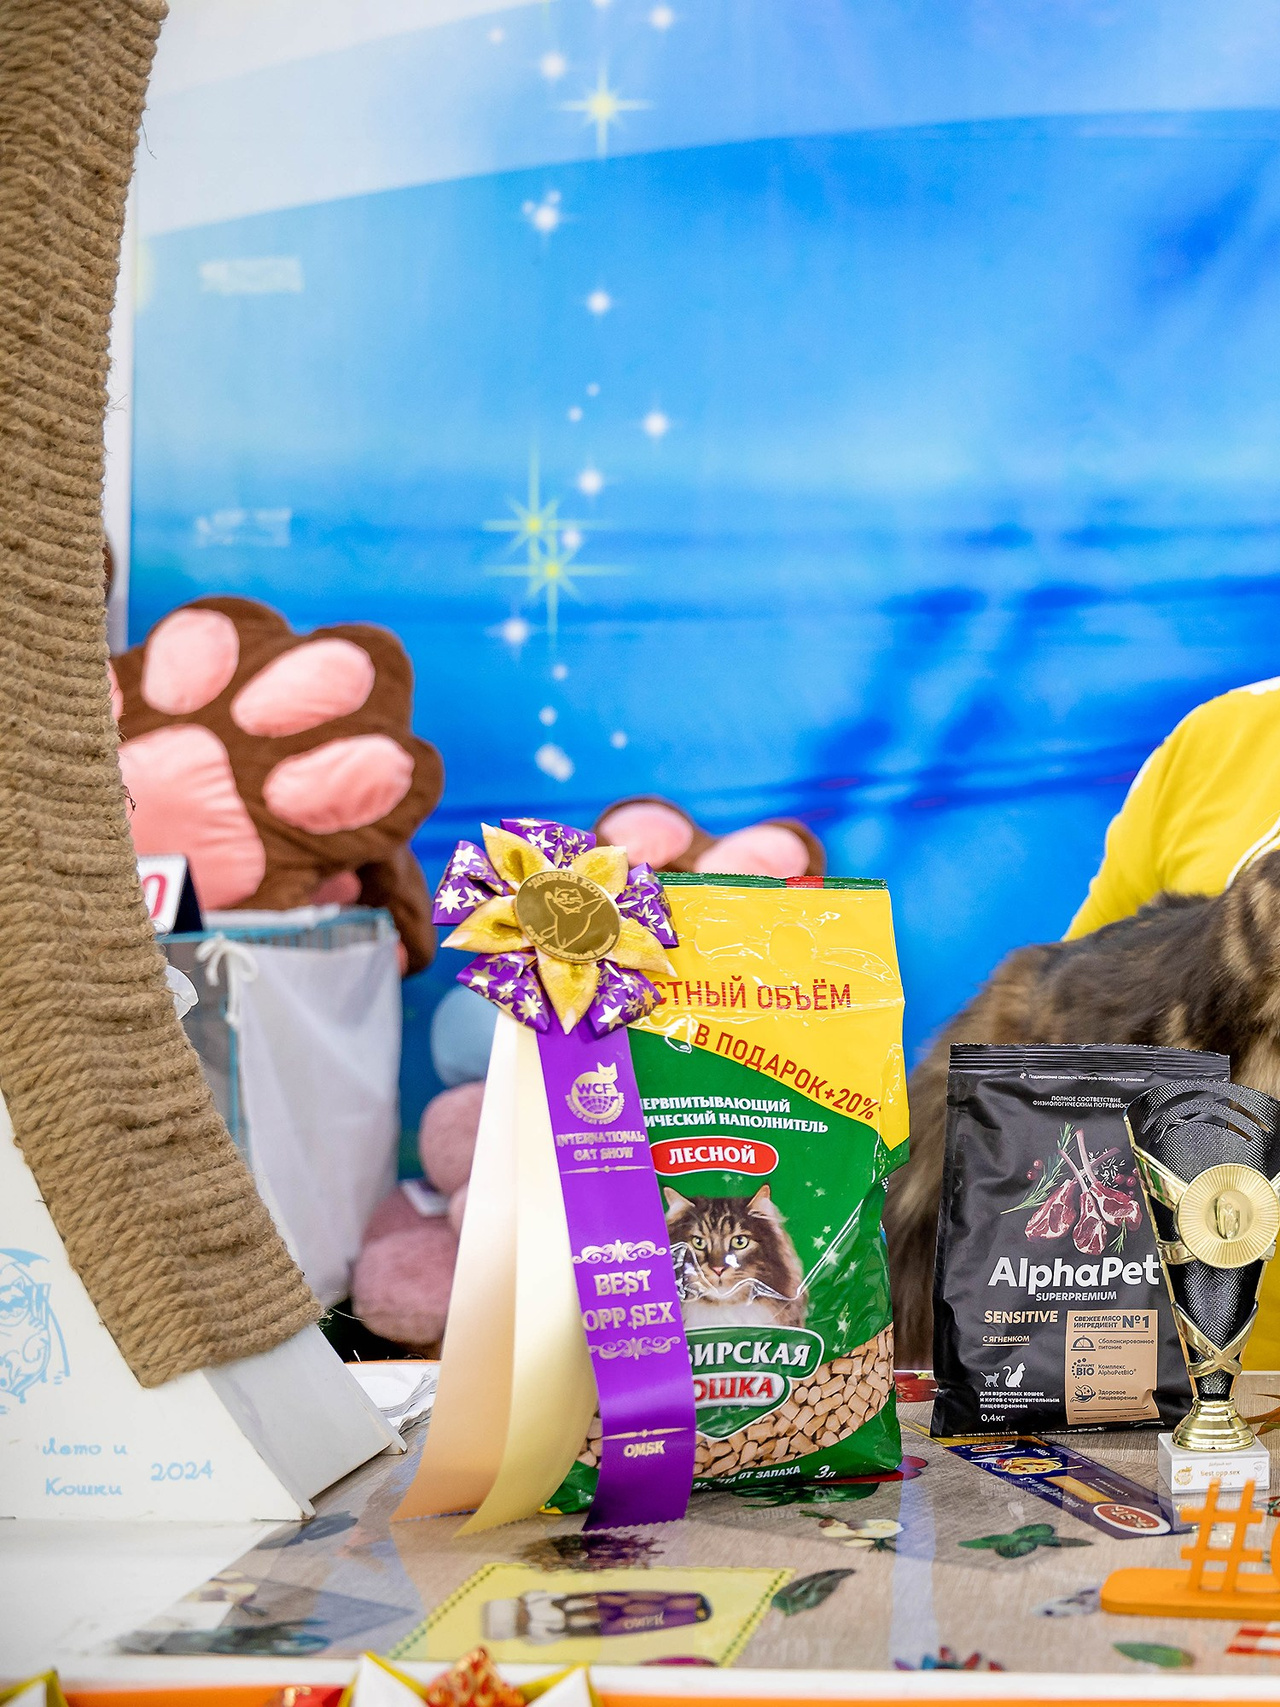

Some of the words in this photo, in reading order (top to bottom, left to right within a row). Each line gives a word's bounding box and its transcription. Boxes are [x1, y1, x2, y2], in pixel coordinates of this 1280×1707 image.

[757, 979, 851, 1011] ОБЪЁМ
[694, 1023, 710, 1046] В
[575, 1082, 612, 1095] WCF
[719, 1114, 829, 1134] НАПОЛНИТЕЛЬ
[556, 1130, 646, 1147] INTERNATIONAL
[573, 1148, 598, 1162] CAT
[601, 1147, 634, 1160] SHOW
[669, 1145, 756, 1165] ЛЕСНОЙ
[594, 1269, 652, 1297] BEST
[988, 1254, 1160, 1295] AlphaPet
[1035, 1291, 1117, 1302] SUPERPREMIUM
[984, 1310, 1059, 1324] SENSITIVE
[989, 1335, 1030, 1343] ЯГНЕНКОМ
[1076, 1367, 1095, 1376] BIO
[623, 1440, 666, 1458] OMSK
[150, 1459, 214, 1482] 2024
[739, 1471, 754, 1479] ОТ
[755, 1465, 801, 1479] ЗАПАХА
[45, 1476, 122, 1496] Кошки
